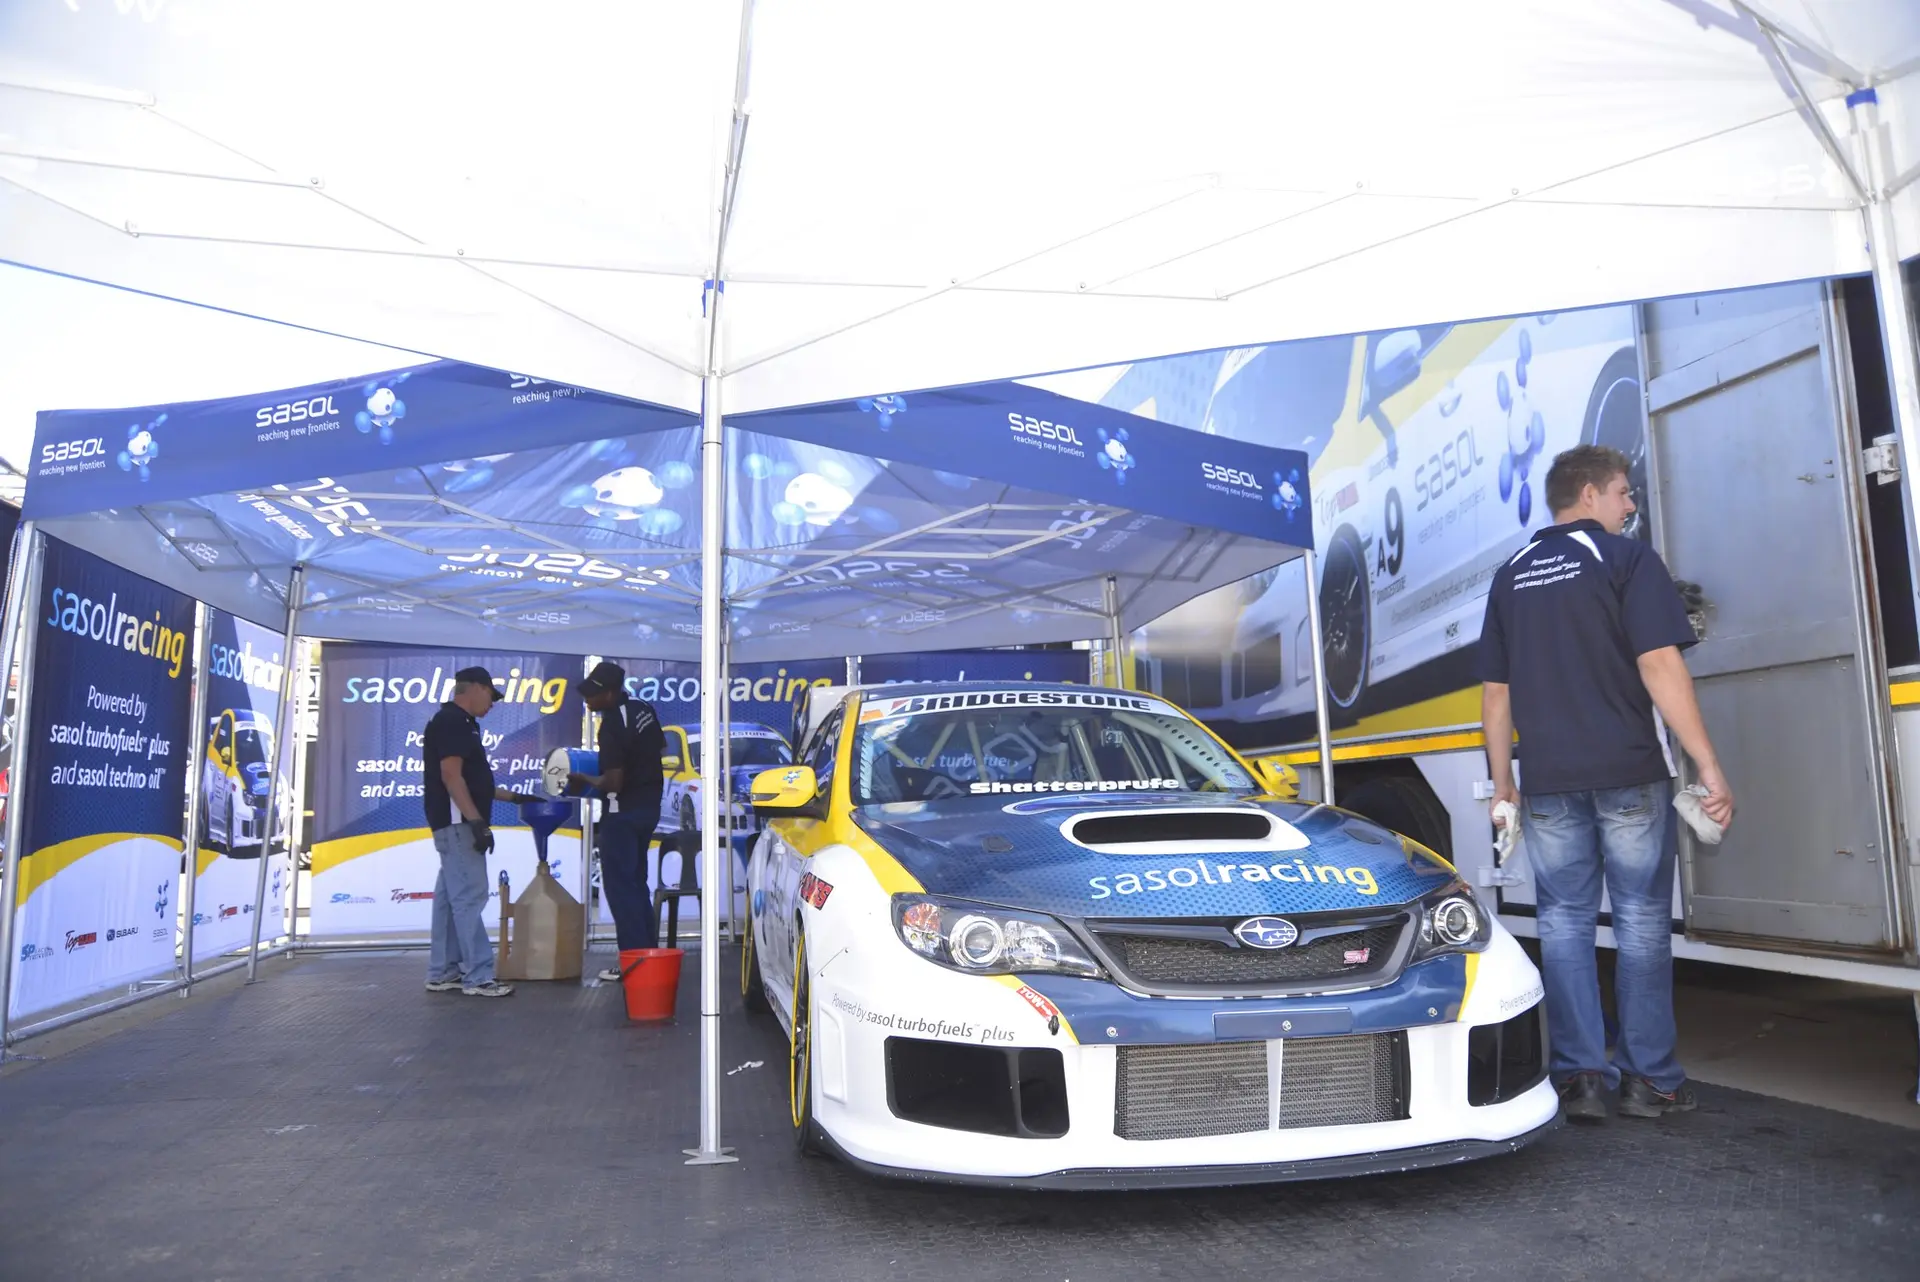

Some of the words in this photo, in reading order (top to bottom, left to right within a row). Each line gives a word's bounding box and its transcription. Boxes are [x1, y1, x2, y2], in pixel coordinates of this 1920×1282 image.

[512, 390, 550, 404] reaching
[553, 387, 571, 398] new
[257, 429, 289, 442] reaching
[291, 426, 307, 436] new
[308, 421, 340, 436] frontiers
[1013, 434, 1042, 449] reaching
[1044, 441, 1057, 451] new
[1058, 444, 1085, 458] frontiers
[39, 463, 65, 476] reaching
[66, 461, 78, 473] new
[79, 460, 106, 473] frontiers
[1206, 483, 1230, 495] reaching
[1230, 488, 1241, 496] new
[1241, 488, 1263, 501] frontiers
[47, 587, 186, 678] sasolracing
[87, 684, 134, 716] Powered
[134, 694, 148, 724] by
[888, 692, 1151, 714] BRIDGESTONE
[49, 721, 86, 746] sasol
[148, 732, 170, 760] plus
[481, 730, 504, 750] by
[51, 760, 78, 786] and
[76, 763, 109, 787] sasol
[109, 765, 147, 789] techno
[356, 756, 401, 773] sasol
[360, 781, 395, 799] and
[396, 785, 424, 798] sas
[970, 777, 1179, 795] Shatterprufe
[1089, 859, 1379, 900] sasolracing
[831, 993, 856, 1020] Powered
[856, 1009, 866, 1022] by
[866, 1011, 895, 1027] sasol
[981, 1025, 1015, 1043] plus
